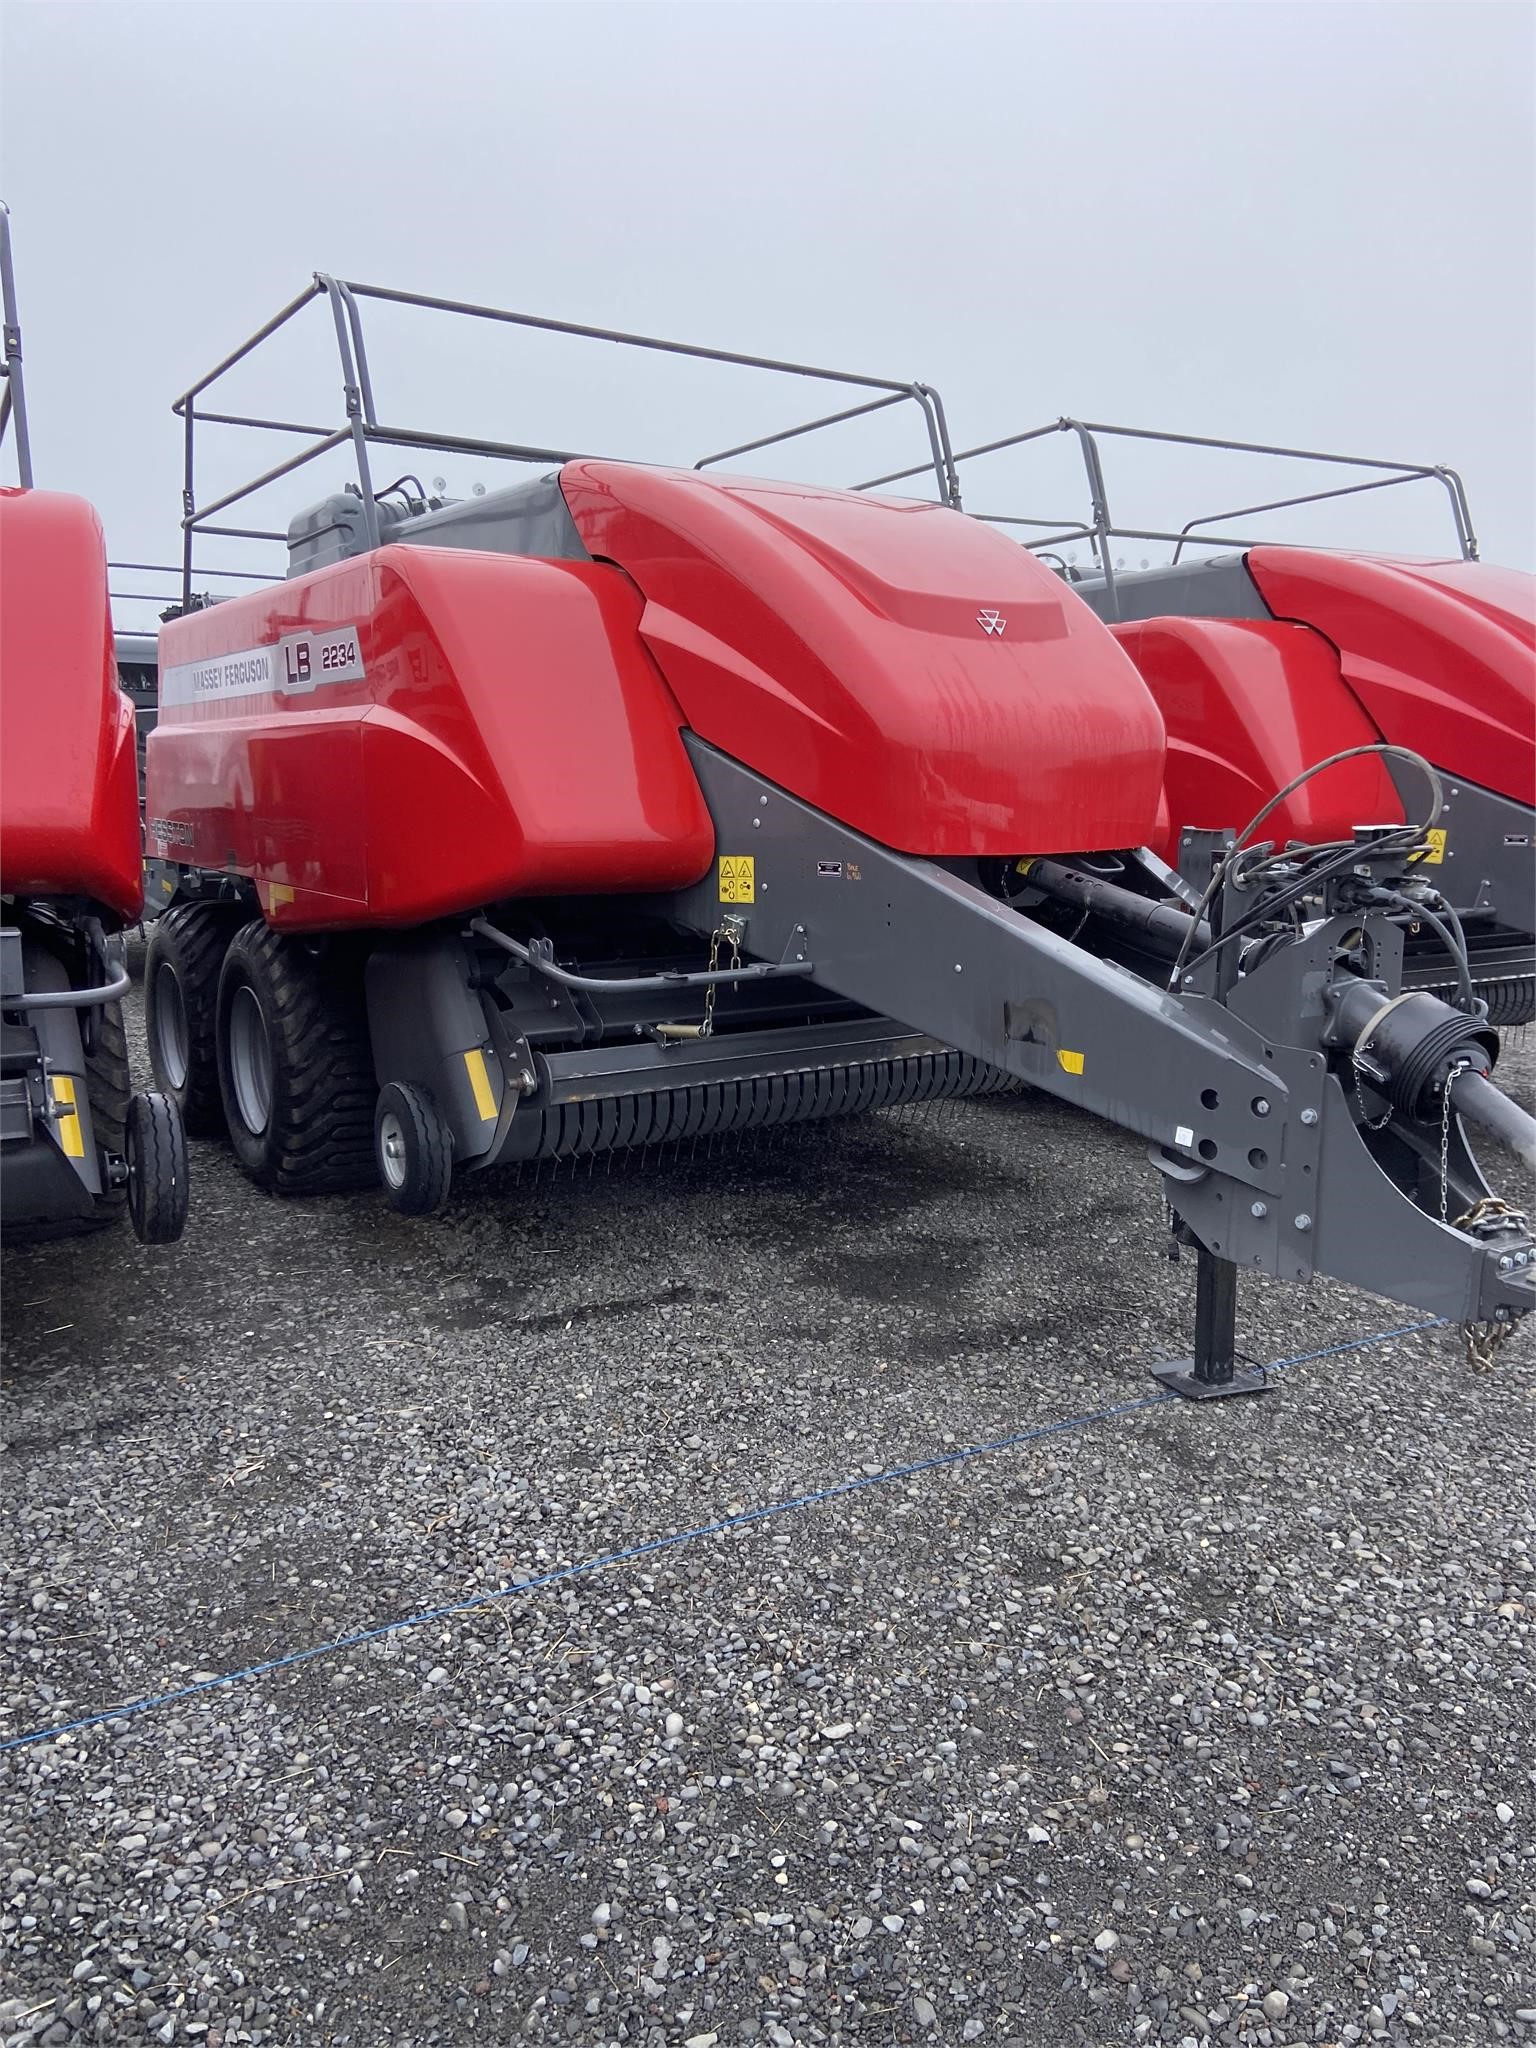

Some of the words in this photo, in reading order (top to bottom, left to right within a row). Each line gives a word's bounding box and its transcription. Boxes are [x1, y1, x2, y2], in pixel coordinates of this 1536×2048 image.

[192, 666, 222, 690] MASSEY
[224, 656, 269, 687] FERGUSON
[284, 642, 311, 685] LB
[322, 641, 356, 671] 2234
